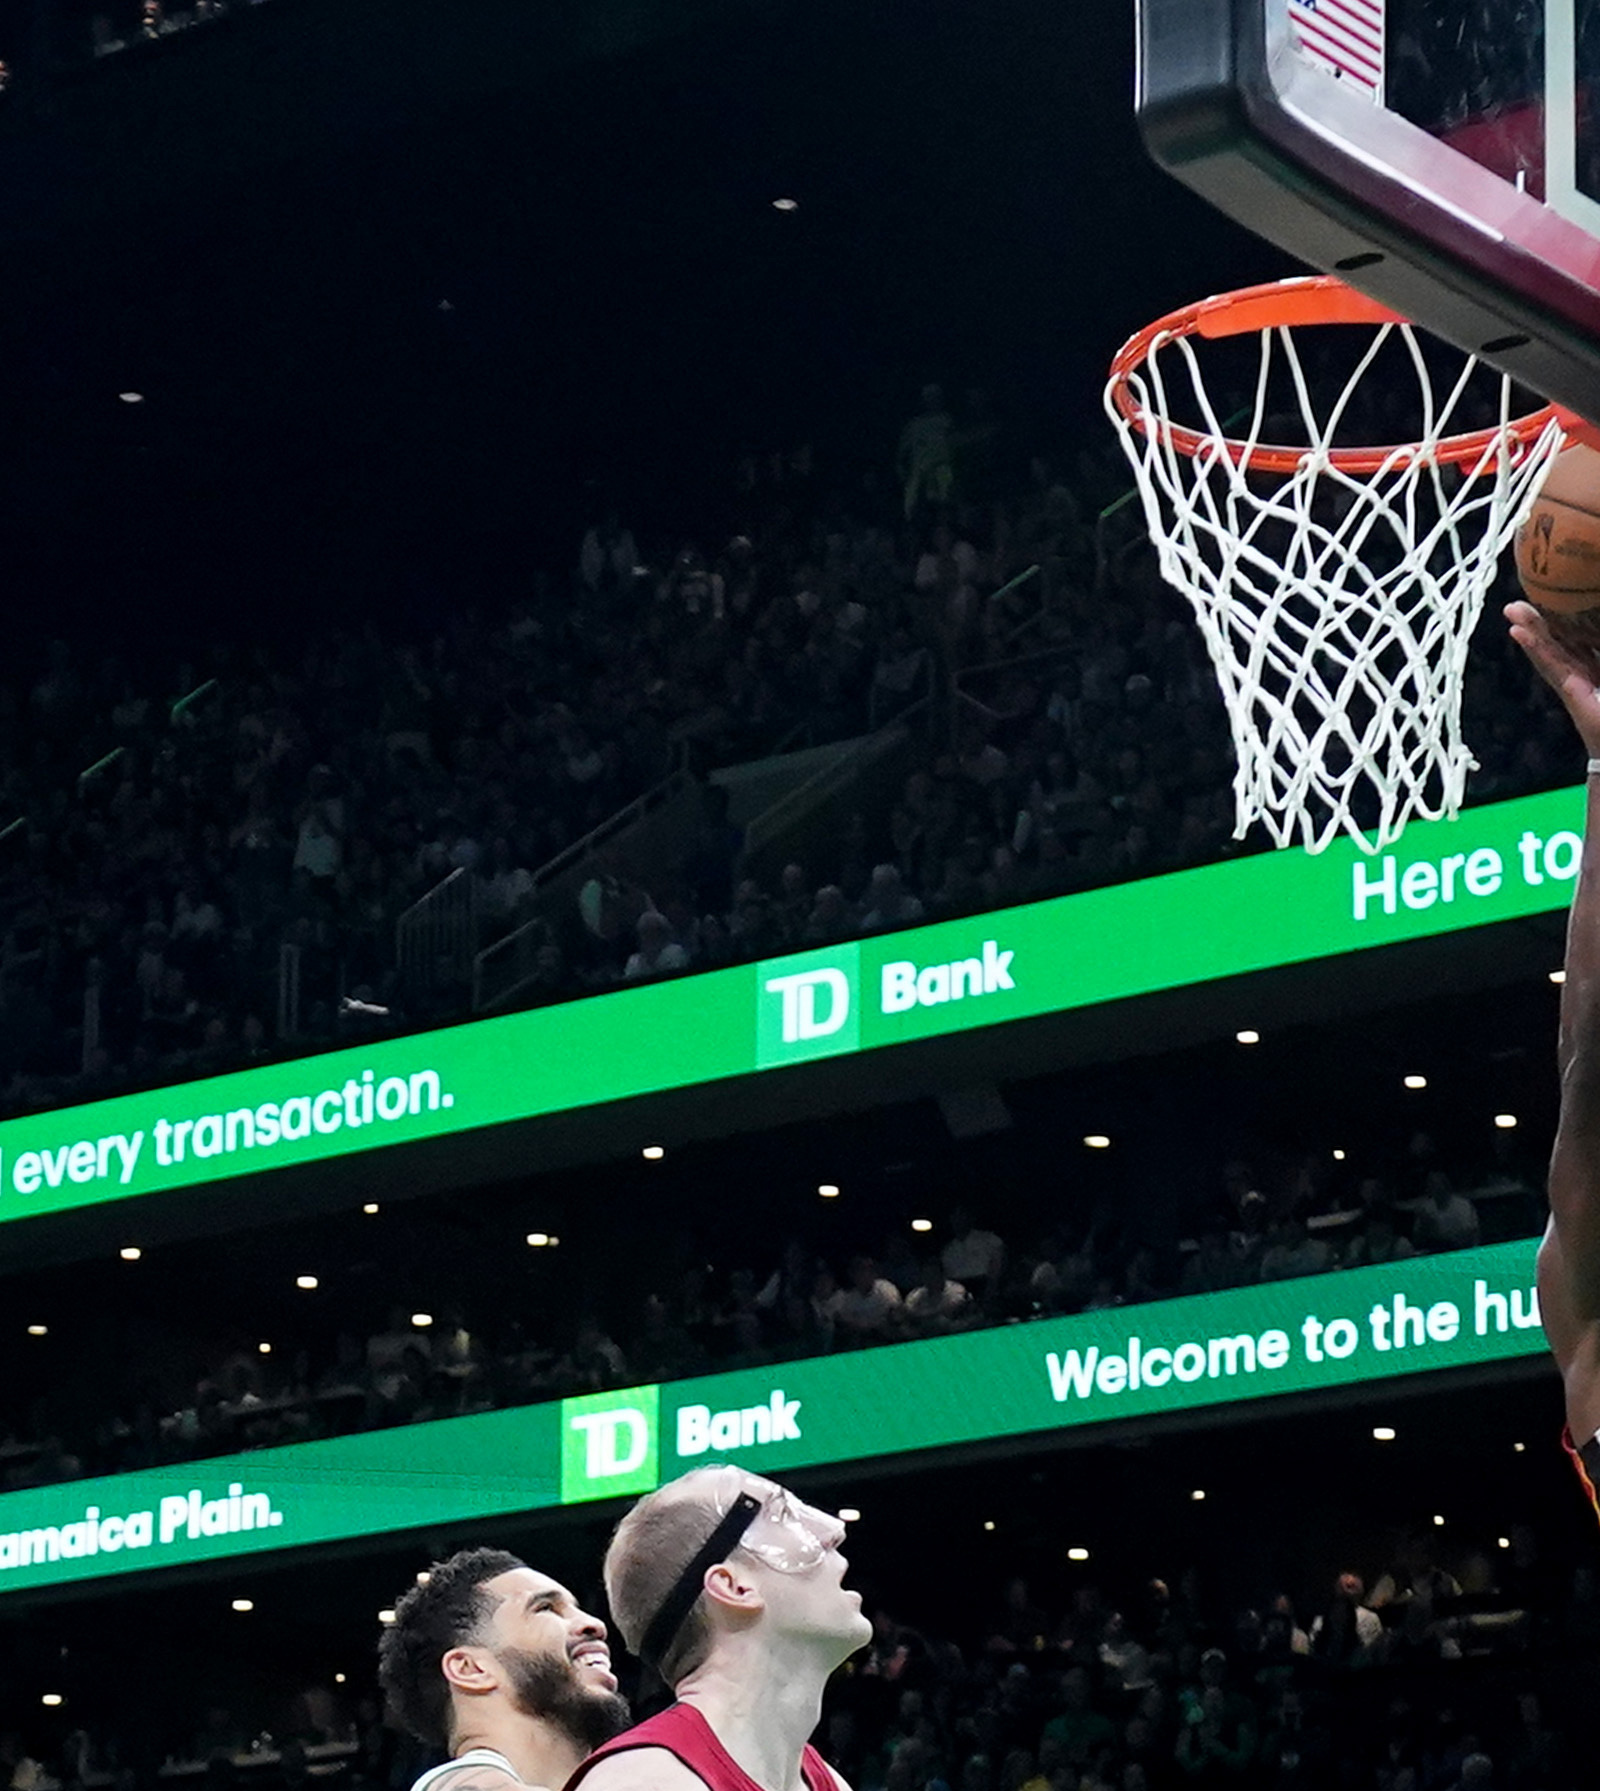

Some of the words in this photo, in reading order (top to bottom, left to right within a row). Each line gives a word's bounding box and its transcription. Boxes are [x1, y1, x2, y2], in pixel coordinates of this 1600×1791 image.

[1352, 848, 1501, 920] Here
[1524, 829, 1581, 887] to
[767, 969, 848, 1041] TD
[882, 941, 1014, 1013] Bank
[14, 1132, 143, 1193] every
[154, 1071, 453, 1165] transaction.
[1047, 1331, 1289, 1401] Welcome
[1302, 1317, 1357, 1361] to
[1370, 1294, 1459, 1350] the
[571, 1411, 649, 1478] TD
[678, 1390, 800, 1465] Bank
[160, 1483, 282, 1543] Plain.
